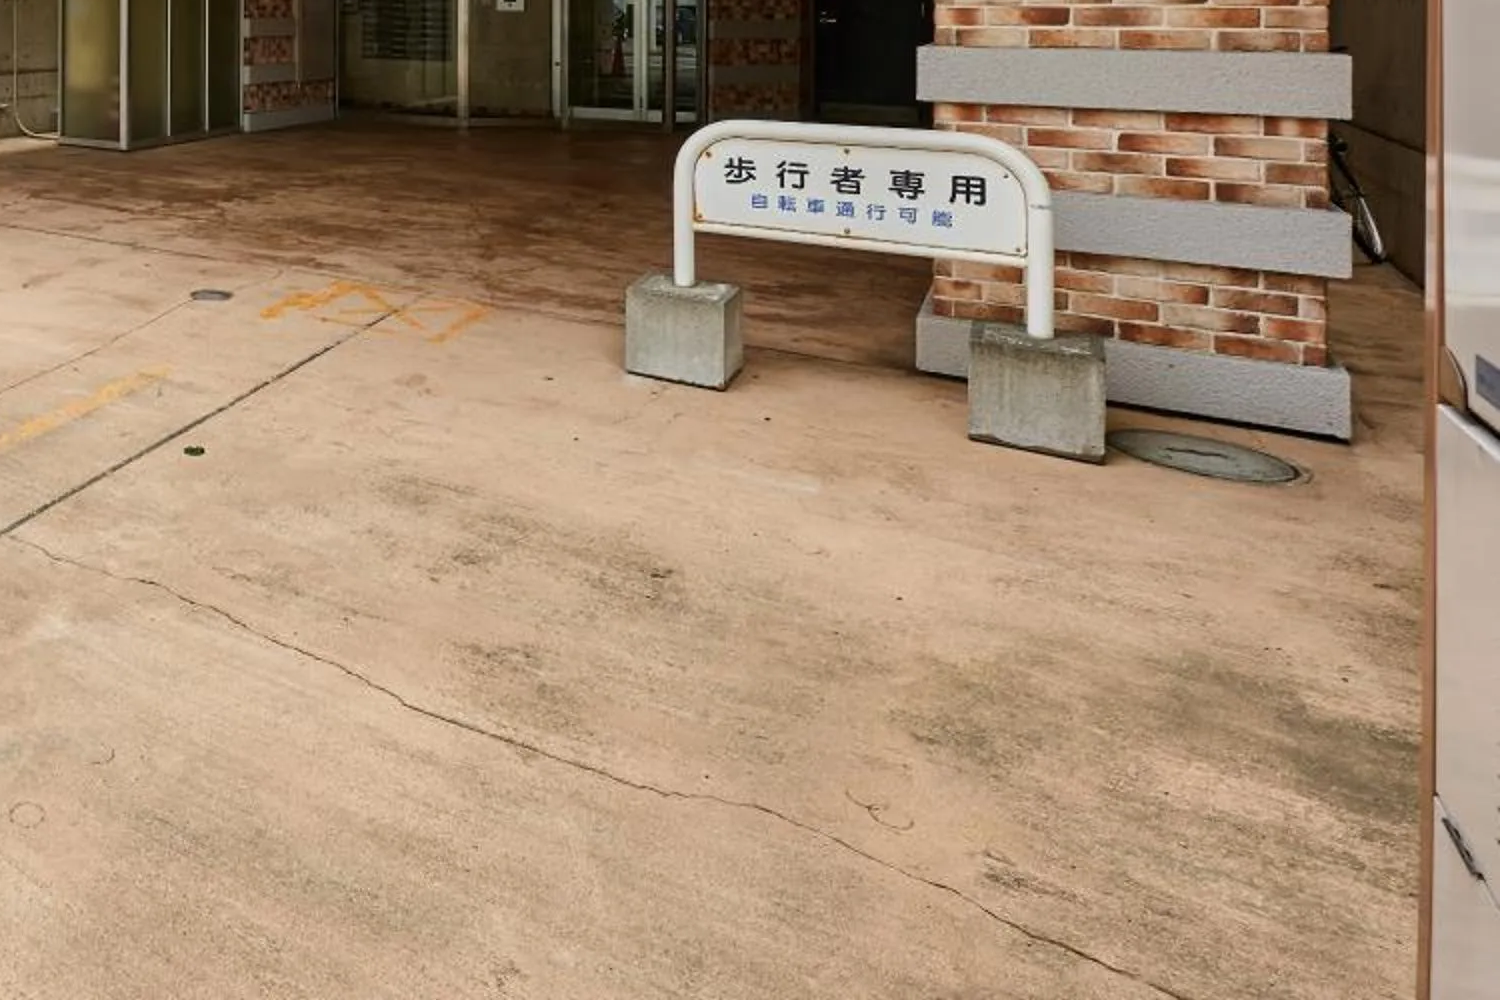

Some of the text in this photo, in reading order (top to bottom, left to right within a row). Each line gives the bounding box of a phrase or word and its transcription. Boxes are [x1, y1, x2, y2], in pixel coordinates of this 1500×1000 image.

[723, 156, 987, 206] 歩行者専用
[750, 192, 953, 228] 自転車通行可能
